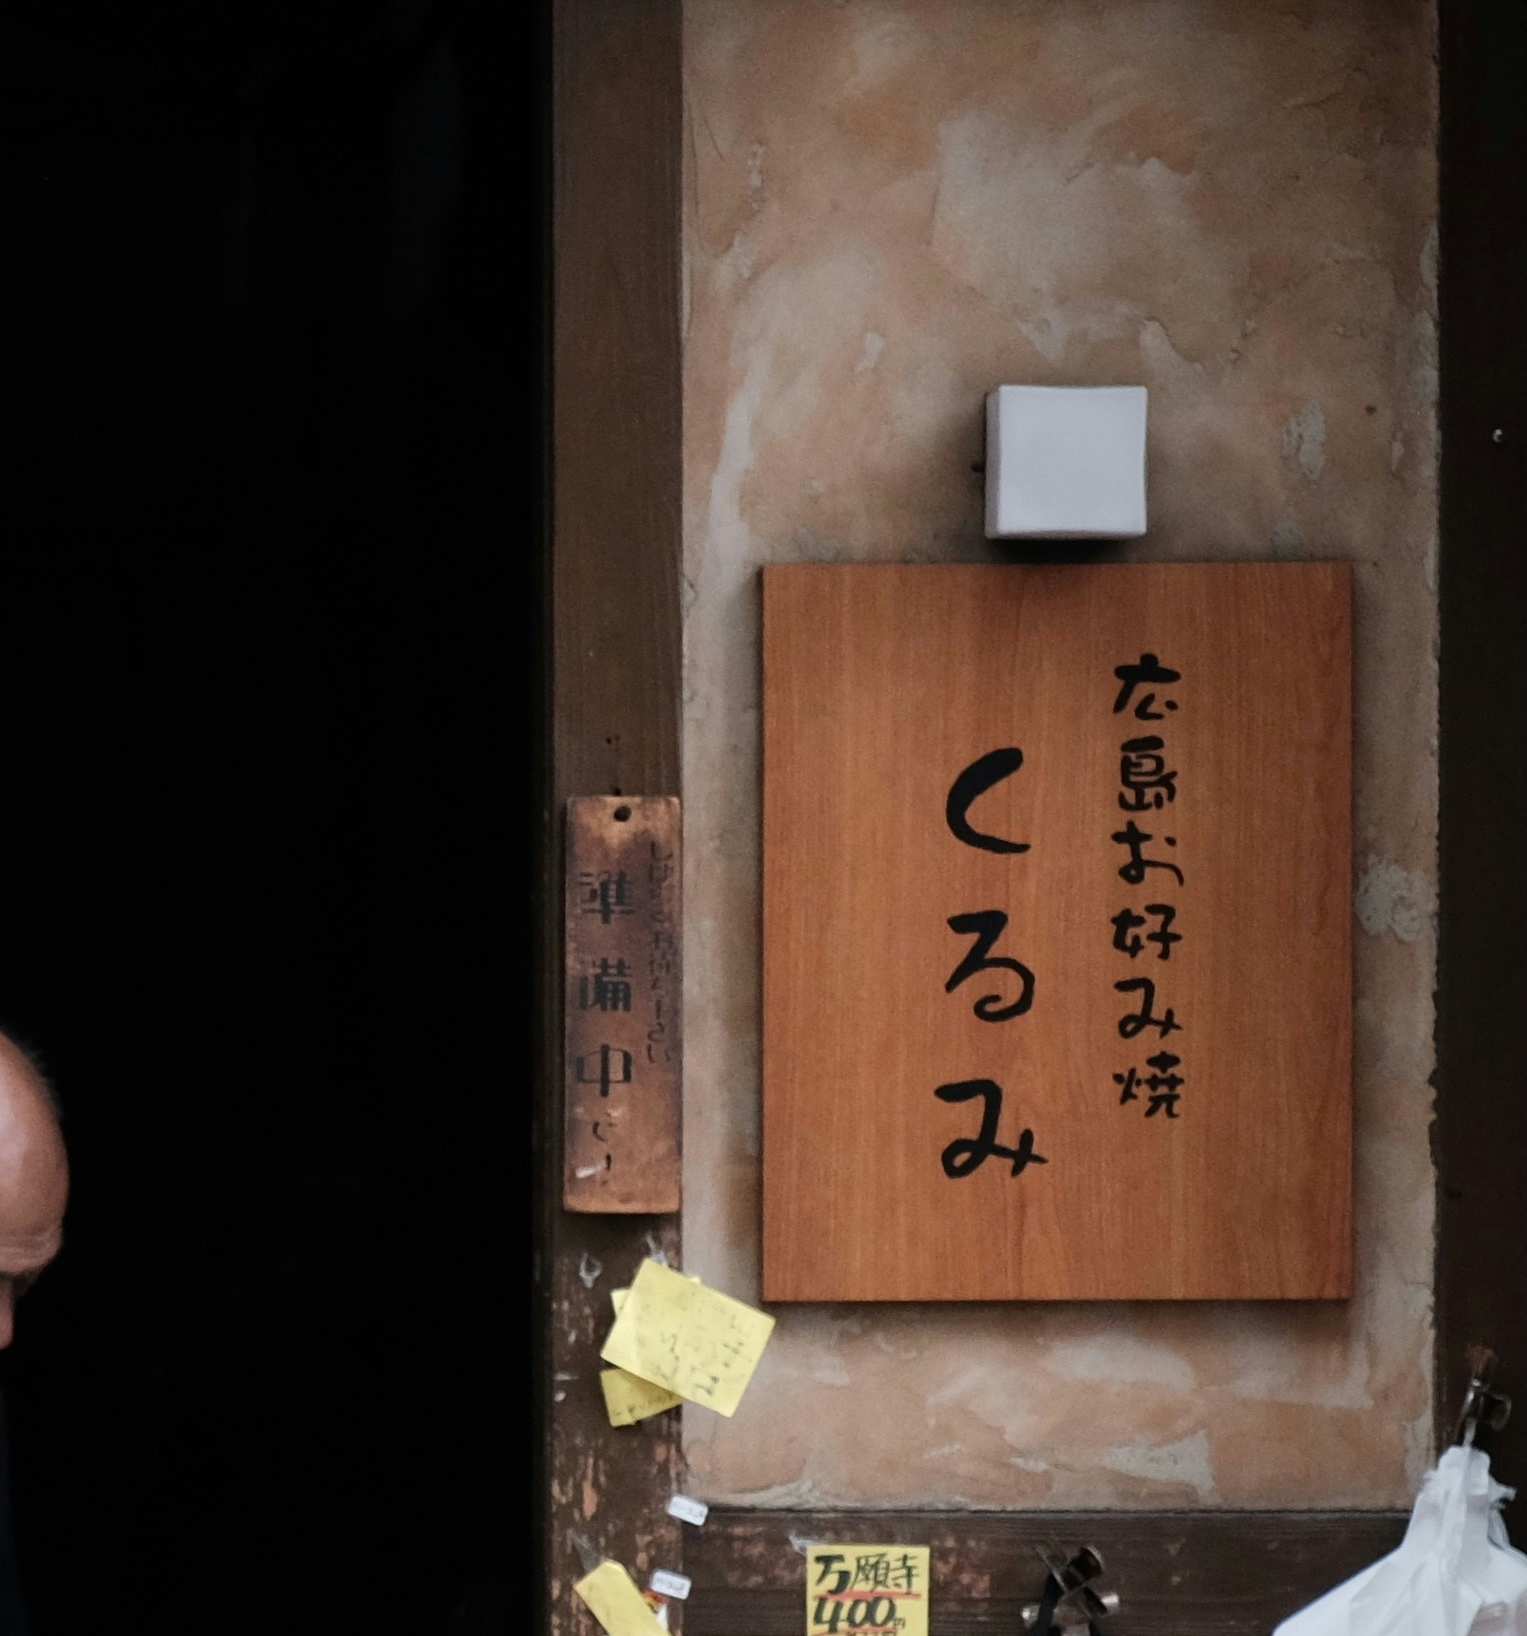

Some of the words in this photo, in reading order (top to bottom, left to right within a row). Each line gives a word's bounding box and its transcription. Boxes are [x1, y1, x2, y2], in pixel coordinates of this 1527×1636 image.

[576, 871, 634, 1098] 準備中
[932, 745, 1048, 1180] くるみ
[1111, 651, 1185, 1121] 広島お好み焼
[814, 1553, 920, 1596] 万願寺
